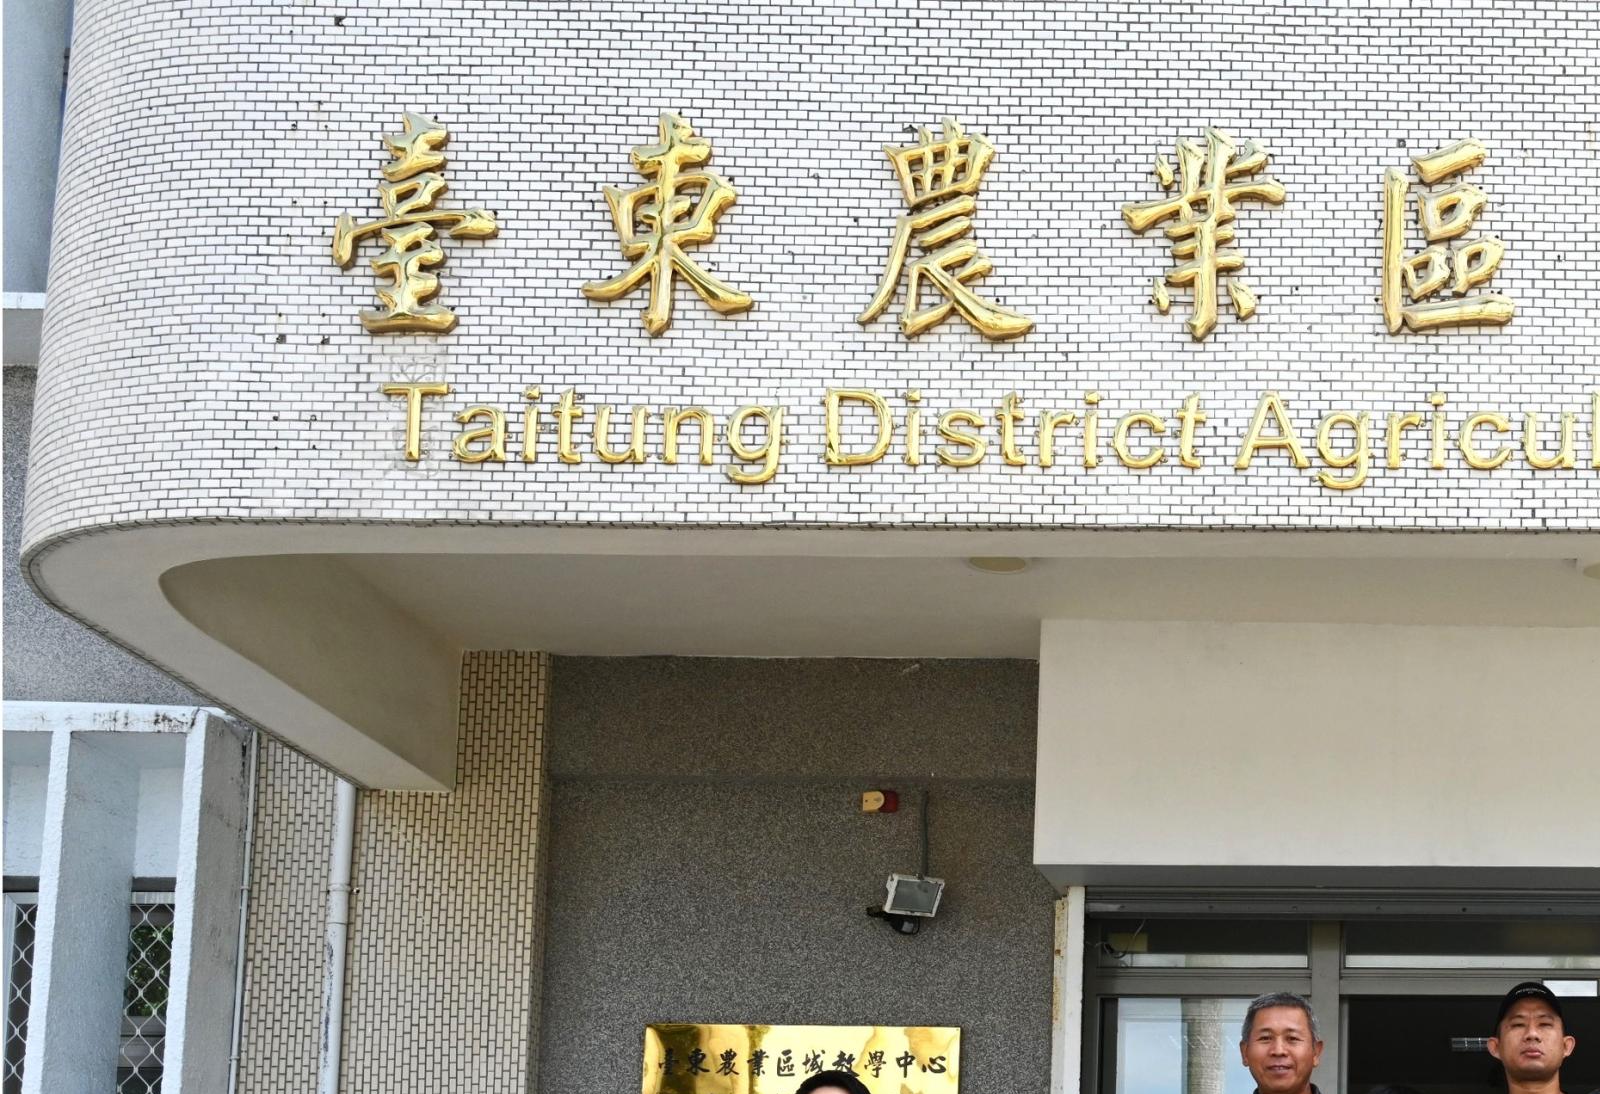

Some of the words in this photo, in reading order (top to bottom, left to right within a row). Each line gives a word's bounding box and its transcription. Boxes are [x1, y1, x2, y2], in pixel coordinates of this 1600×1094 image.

[383, 383, 788, 484] Taitung
[823, 386, 1205, 470] District
[658, 1048, 947, 1079] 臺東農業區域教學中心
